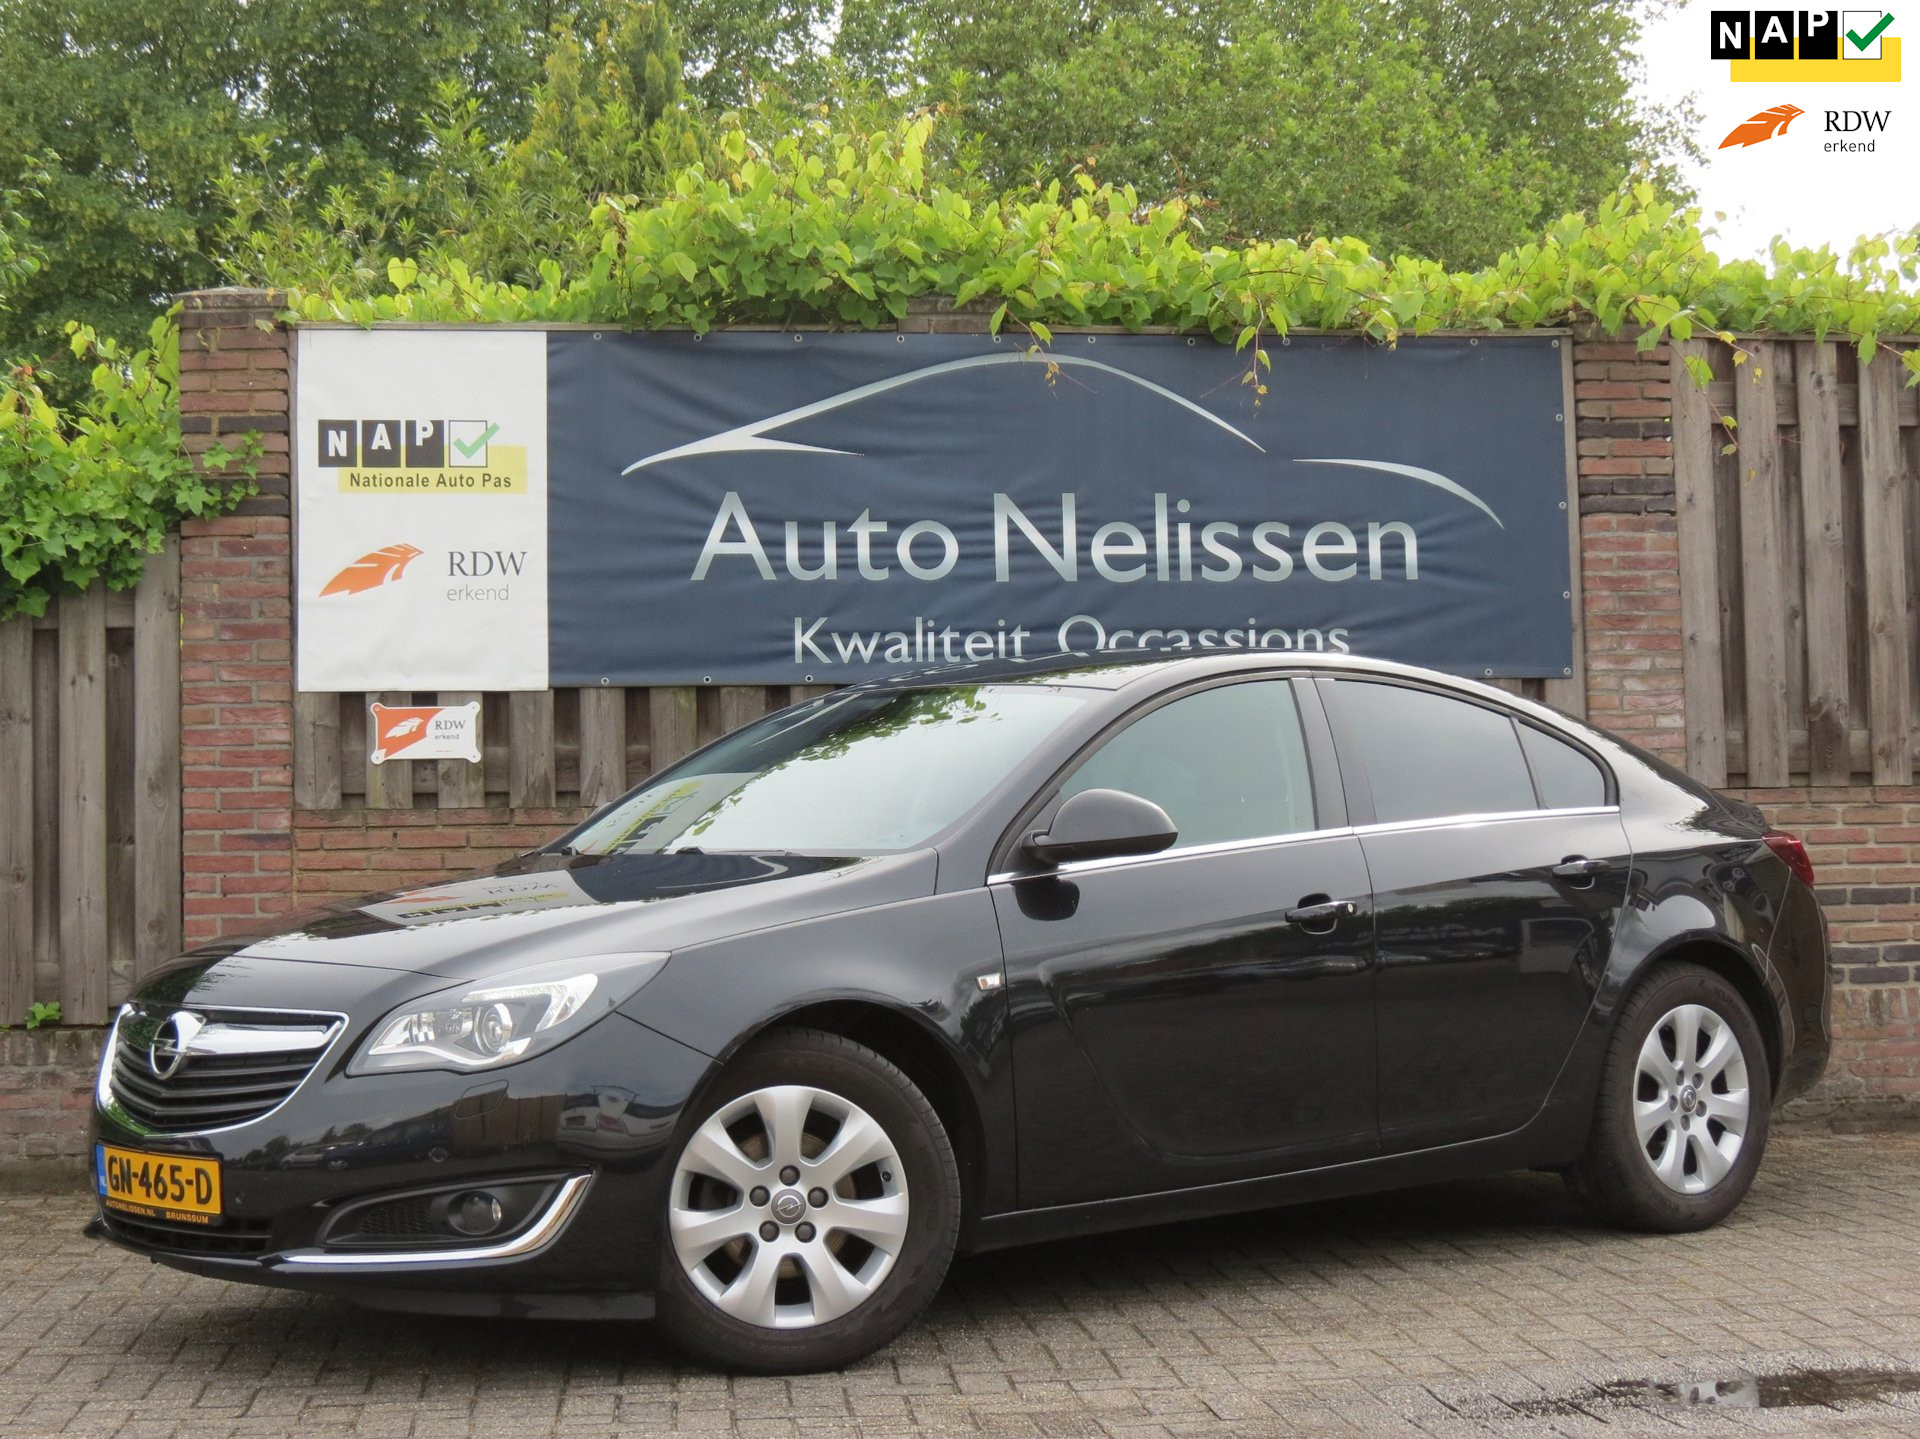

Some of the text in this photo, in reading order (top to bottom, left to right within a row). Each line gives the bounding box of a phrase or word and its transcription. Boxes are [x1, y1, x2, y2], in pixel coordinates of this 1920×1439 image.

[328, 420, 434, 457] NAP
[350, 473, 512, 488] Nationale Auto Pas
[690, 492, 1419, 582] Auto Nelissen
[448, 551, 528, 577] RDW
[447, 583, 509, 601] erkend
[795, 616, 1030, 664] Kwaliteit
[434, 720, 467, 731] RDW
[107, 1155, 212, 1205] GN-465-D
[165, 1211, 209, 1224] BRUNSSUM
